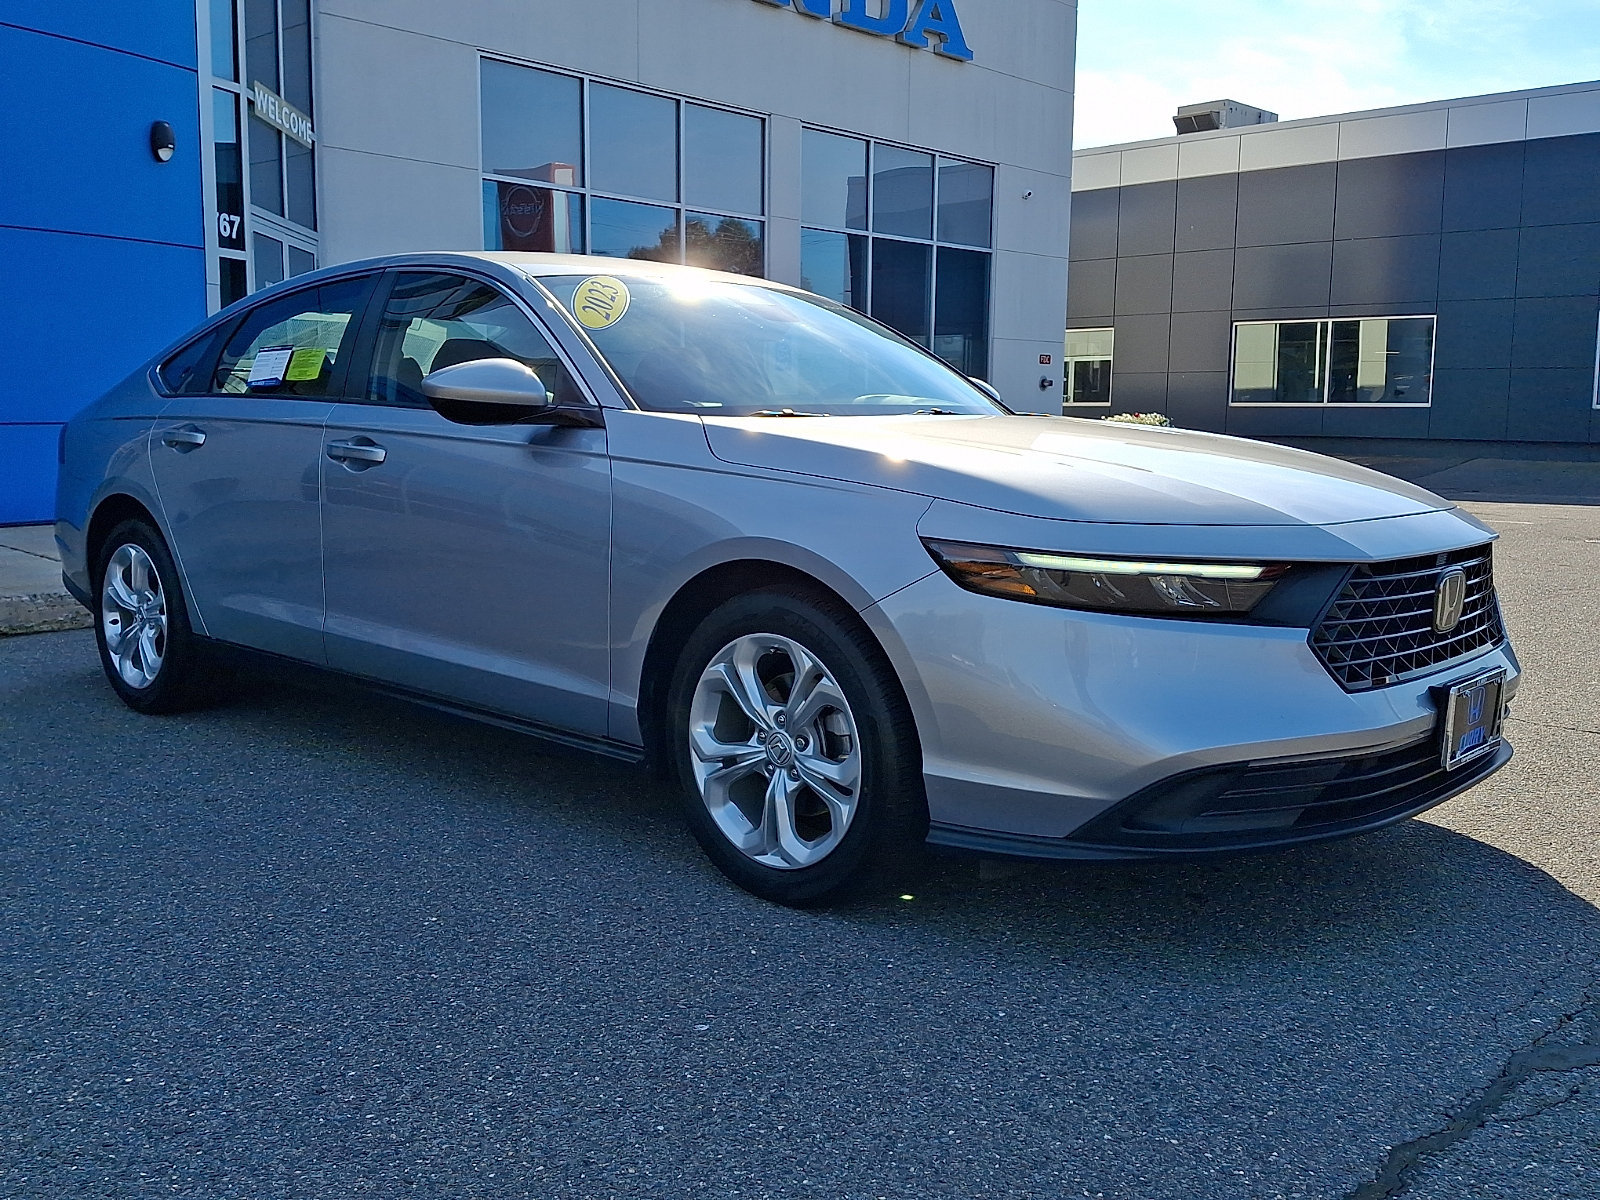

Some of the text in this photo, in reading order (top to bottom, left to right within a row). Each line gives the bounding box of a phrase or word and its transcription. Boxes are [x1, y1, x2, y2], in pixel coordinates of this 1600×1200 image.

[254, 86, 312, 144] WELCOME
[216, 211, 241, 239] 67
[582, 281, 619, 321] 2023
